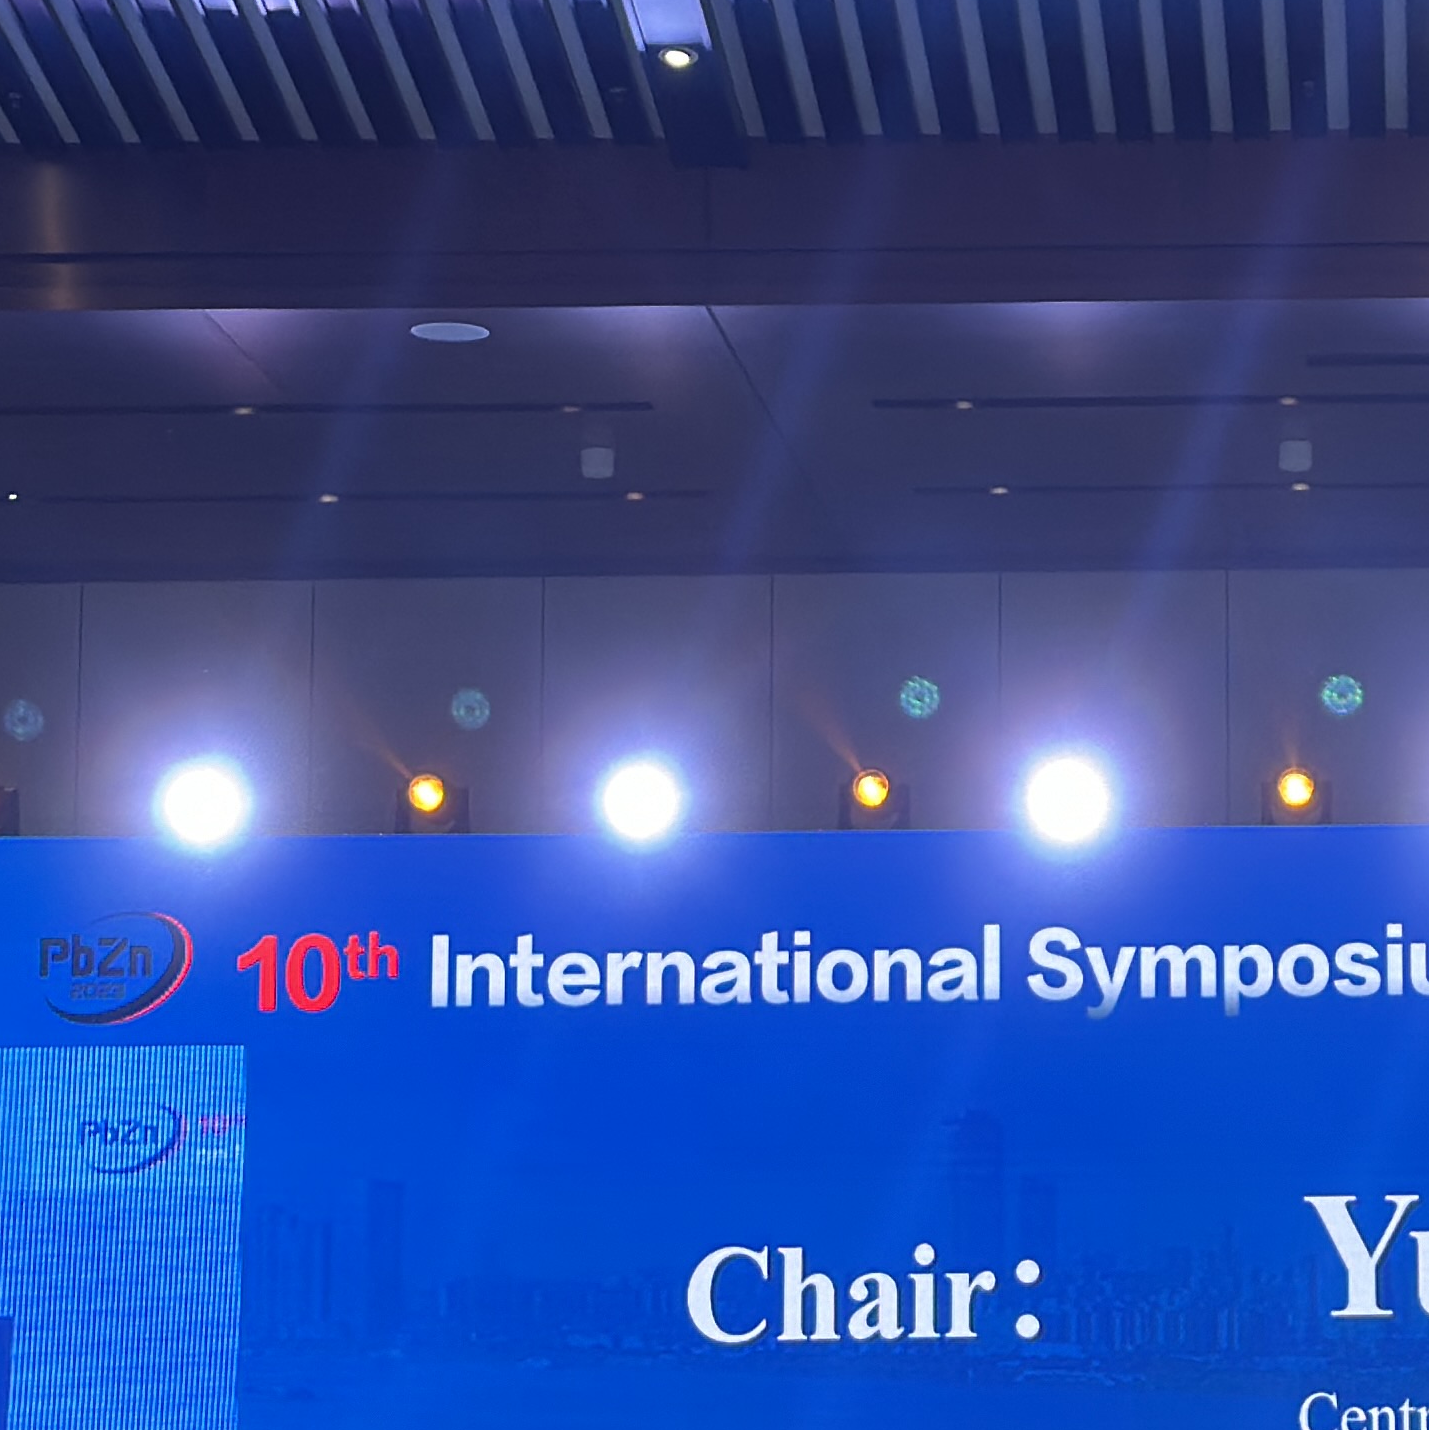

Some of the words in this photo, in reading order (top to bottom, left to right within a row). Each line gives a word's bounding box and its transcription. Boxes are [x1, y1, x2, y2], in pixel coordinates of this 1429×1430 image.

[39, 934, 153, 979] PbZn
[236, 930, 399, 1013] 10th
[431, 923, 1001, 1008] International
[687, 1241, 1041, 1344] Chair:
